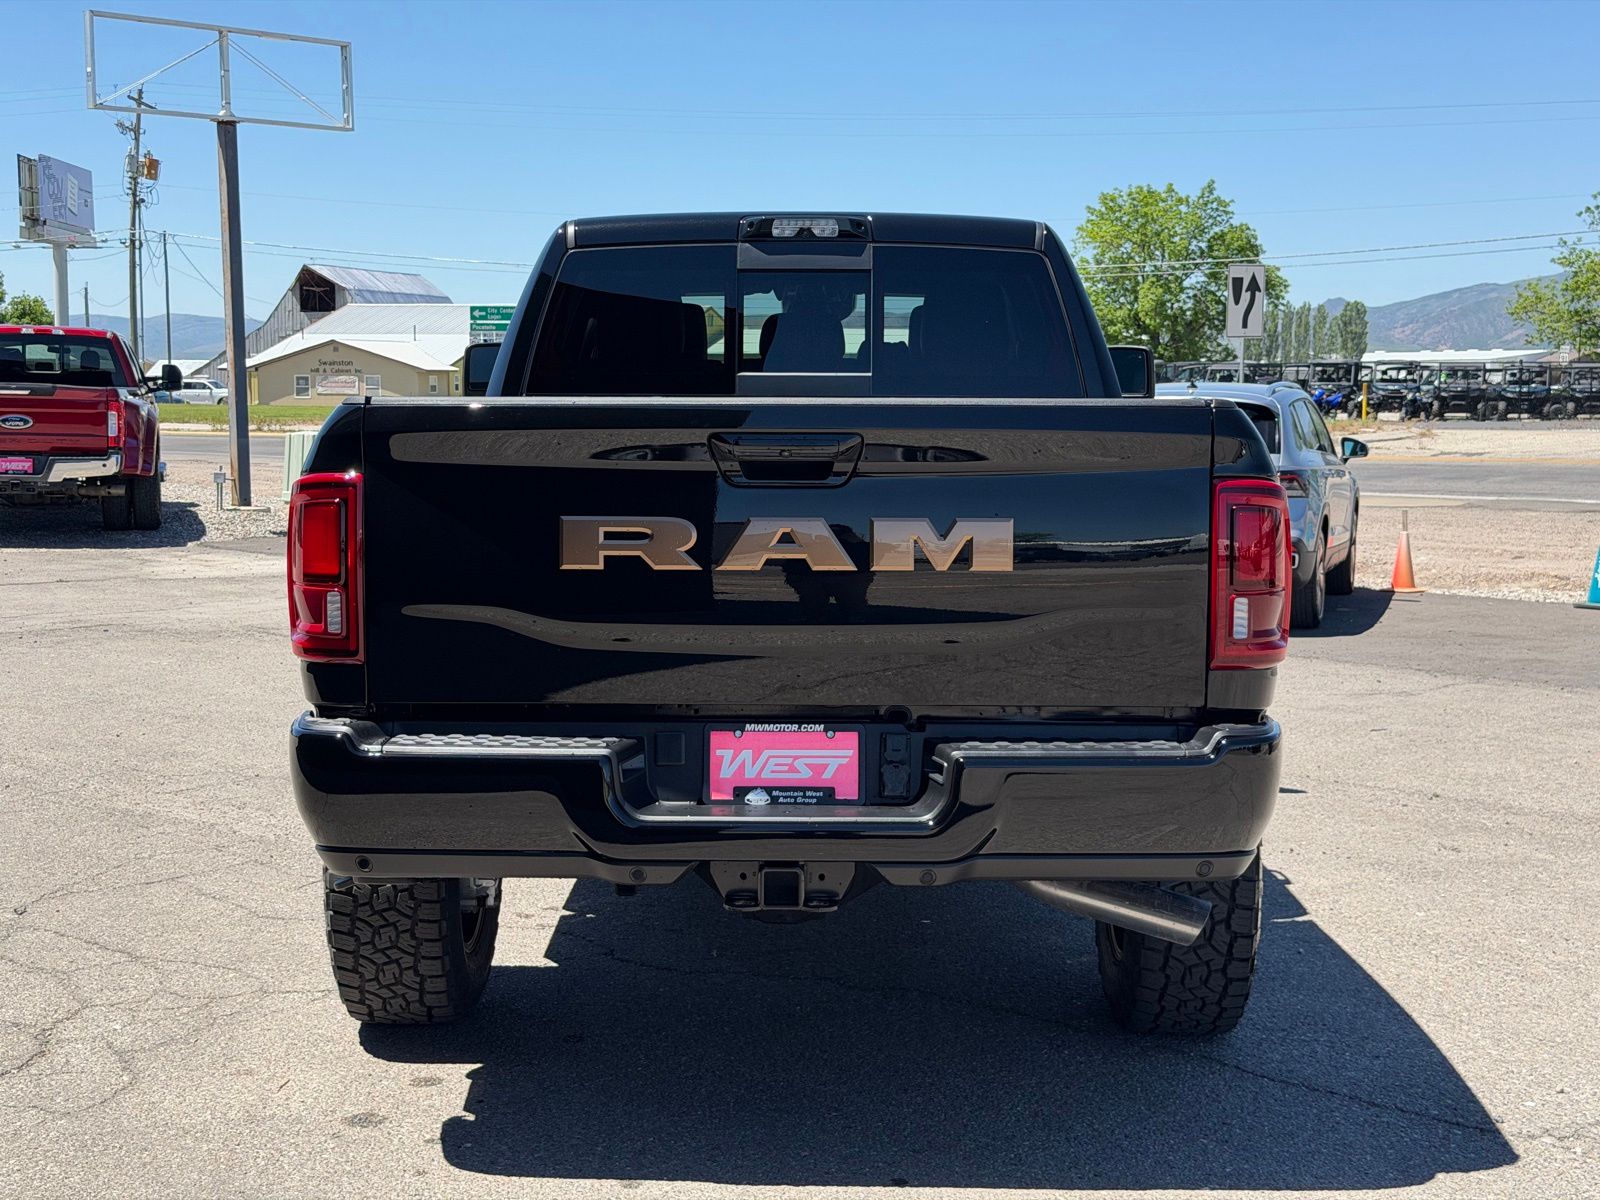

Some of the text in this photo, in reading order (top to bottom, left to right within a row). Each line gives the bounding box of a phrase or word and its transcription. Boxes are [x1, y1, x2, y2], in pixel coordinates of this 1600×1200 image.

[559, 516, 1014, 571] RAM
[744, 723, 825, 732] MWMOTOR.COM
[715, 749, 854, 779] WEST
